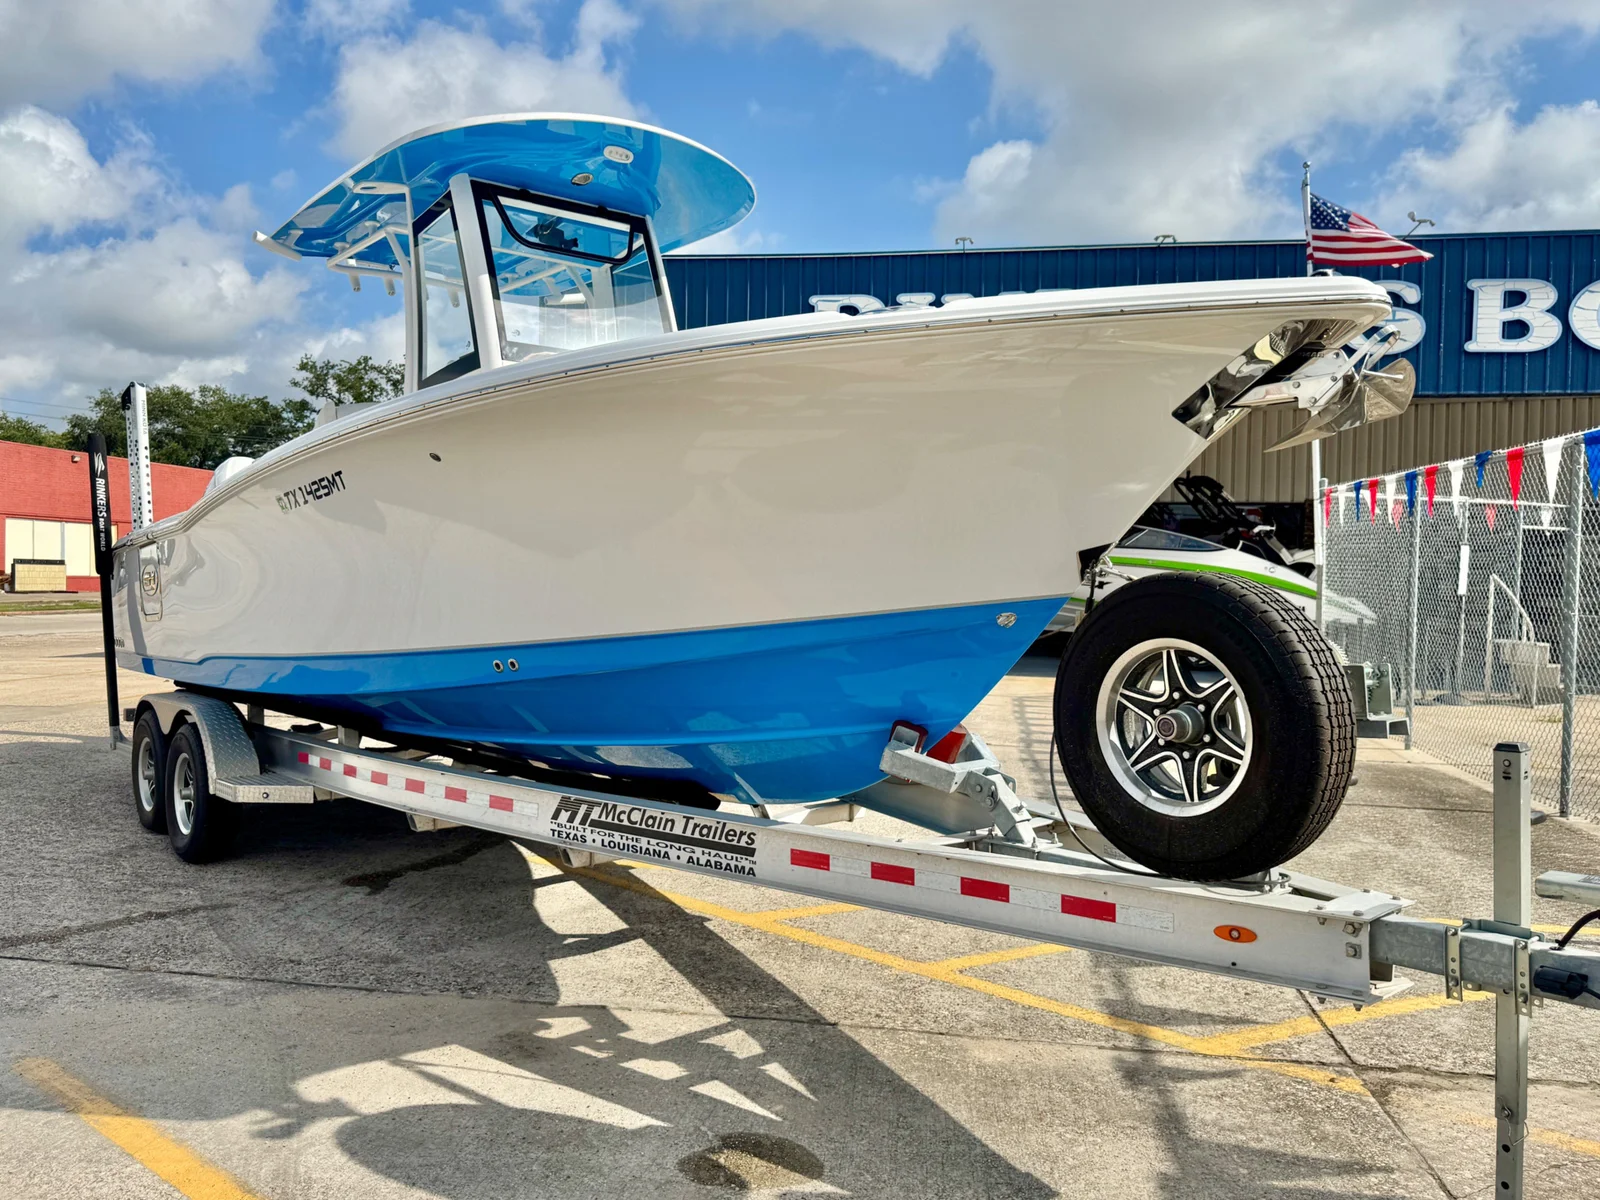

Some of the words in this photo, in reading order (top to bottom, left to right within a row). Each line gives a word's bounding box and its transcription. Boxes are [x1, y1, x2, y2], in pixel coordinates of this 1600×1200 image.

[95, 477, 107, 518] RINKERS
[283, 491, 301, 510] TX
[590, 829, 616, 839] FOR
[618, 834, 642, 844] THE
[647, 840, 696, 854] LONG
[598, 802, 676, 832] McClain
[682, 815, 757, 846] Trailers
[550, 828, 587, 844] TEXAS
[601, 838, 671, 860] LOUISIANA
[686, 855, 757, 878] ALABAMA
